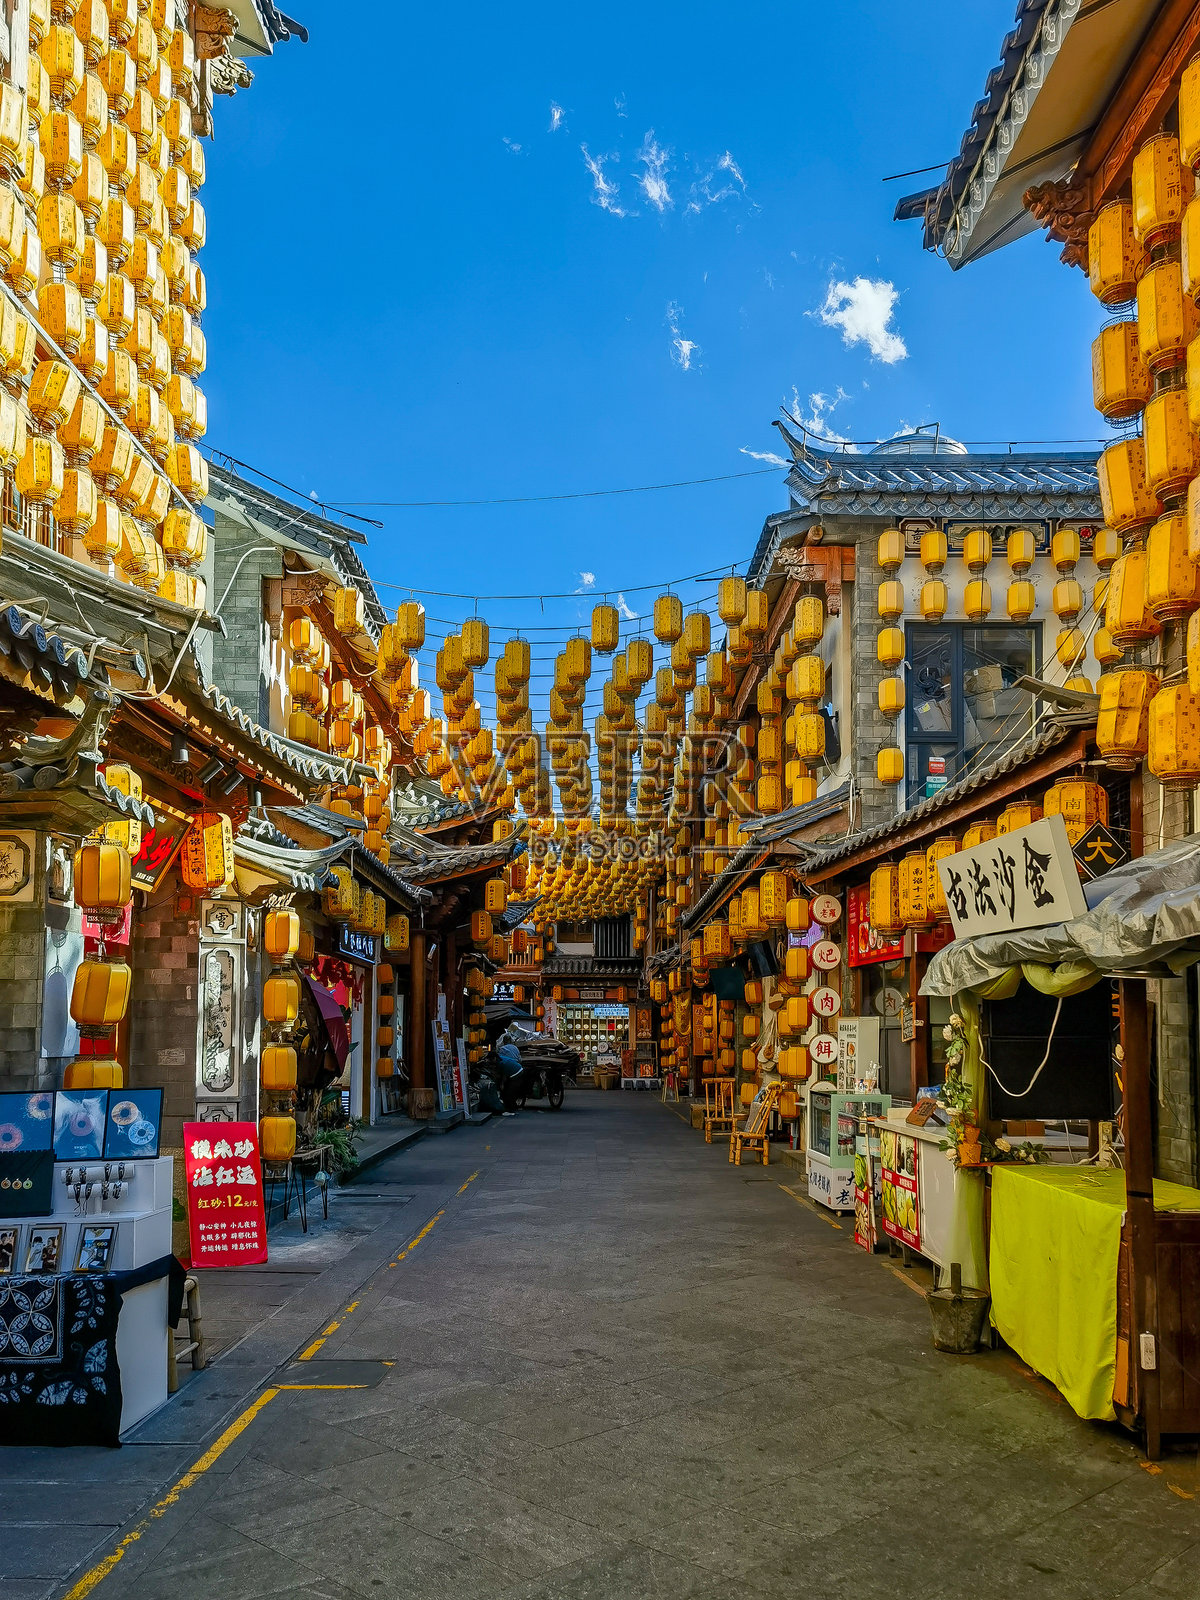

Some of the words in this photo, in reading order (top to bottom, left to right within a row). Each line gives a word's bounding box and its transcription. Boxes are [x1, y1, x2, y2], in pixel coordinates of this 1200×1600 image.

[1084, 836, 1117, 864] 大
[946, 836, 1055, 923] 古法沙金
[820, 992, 834, 1012] 肉
[192, 1164, 257, 1188] 沾红运
